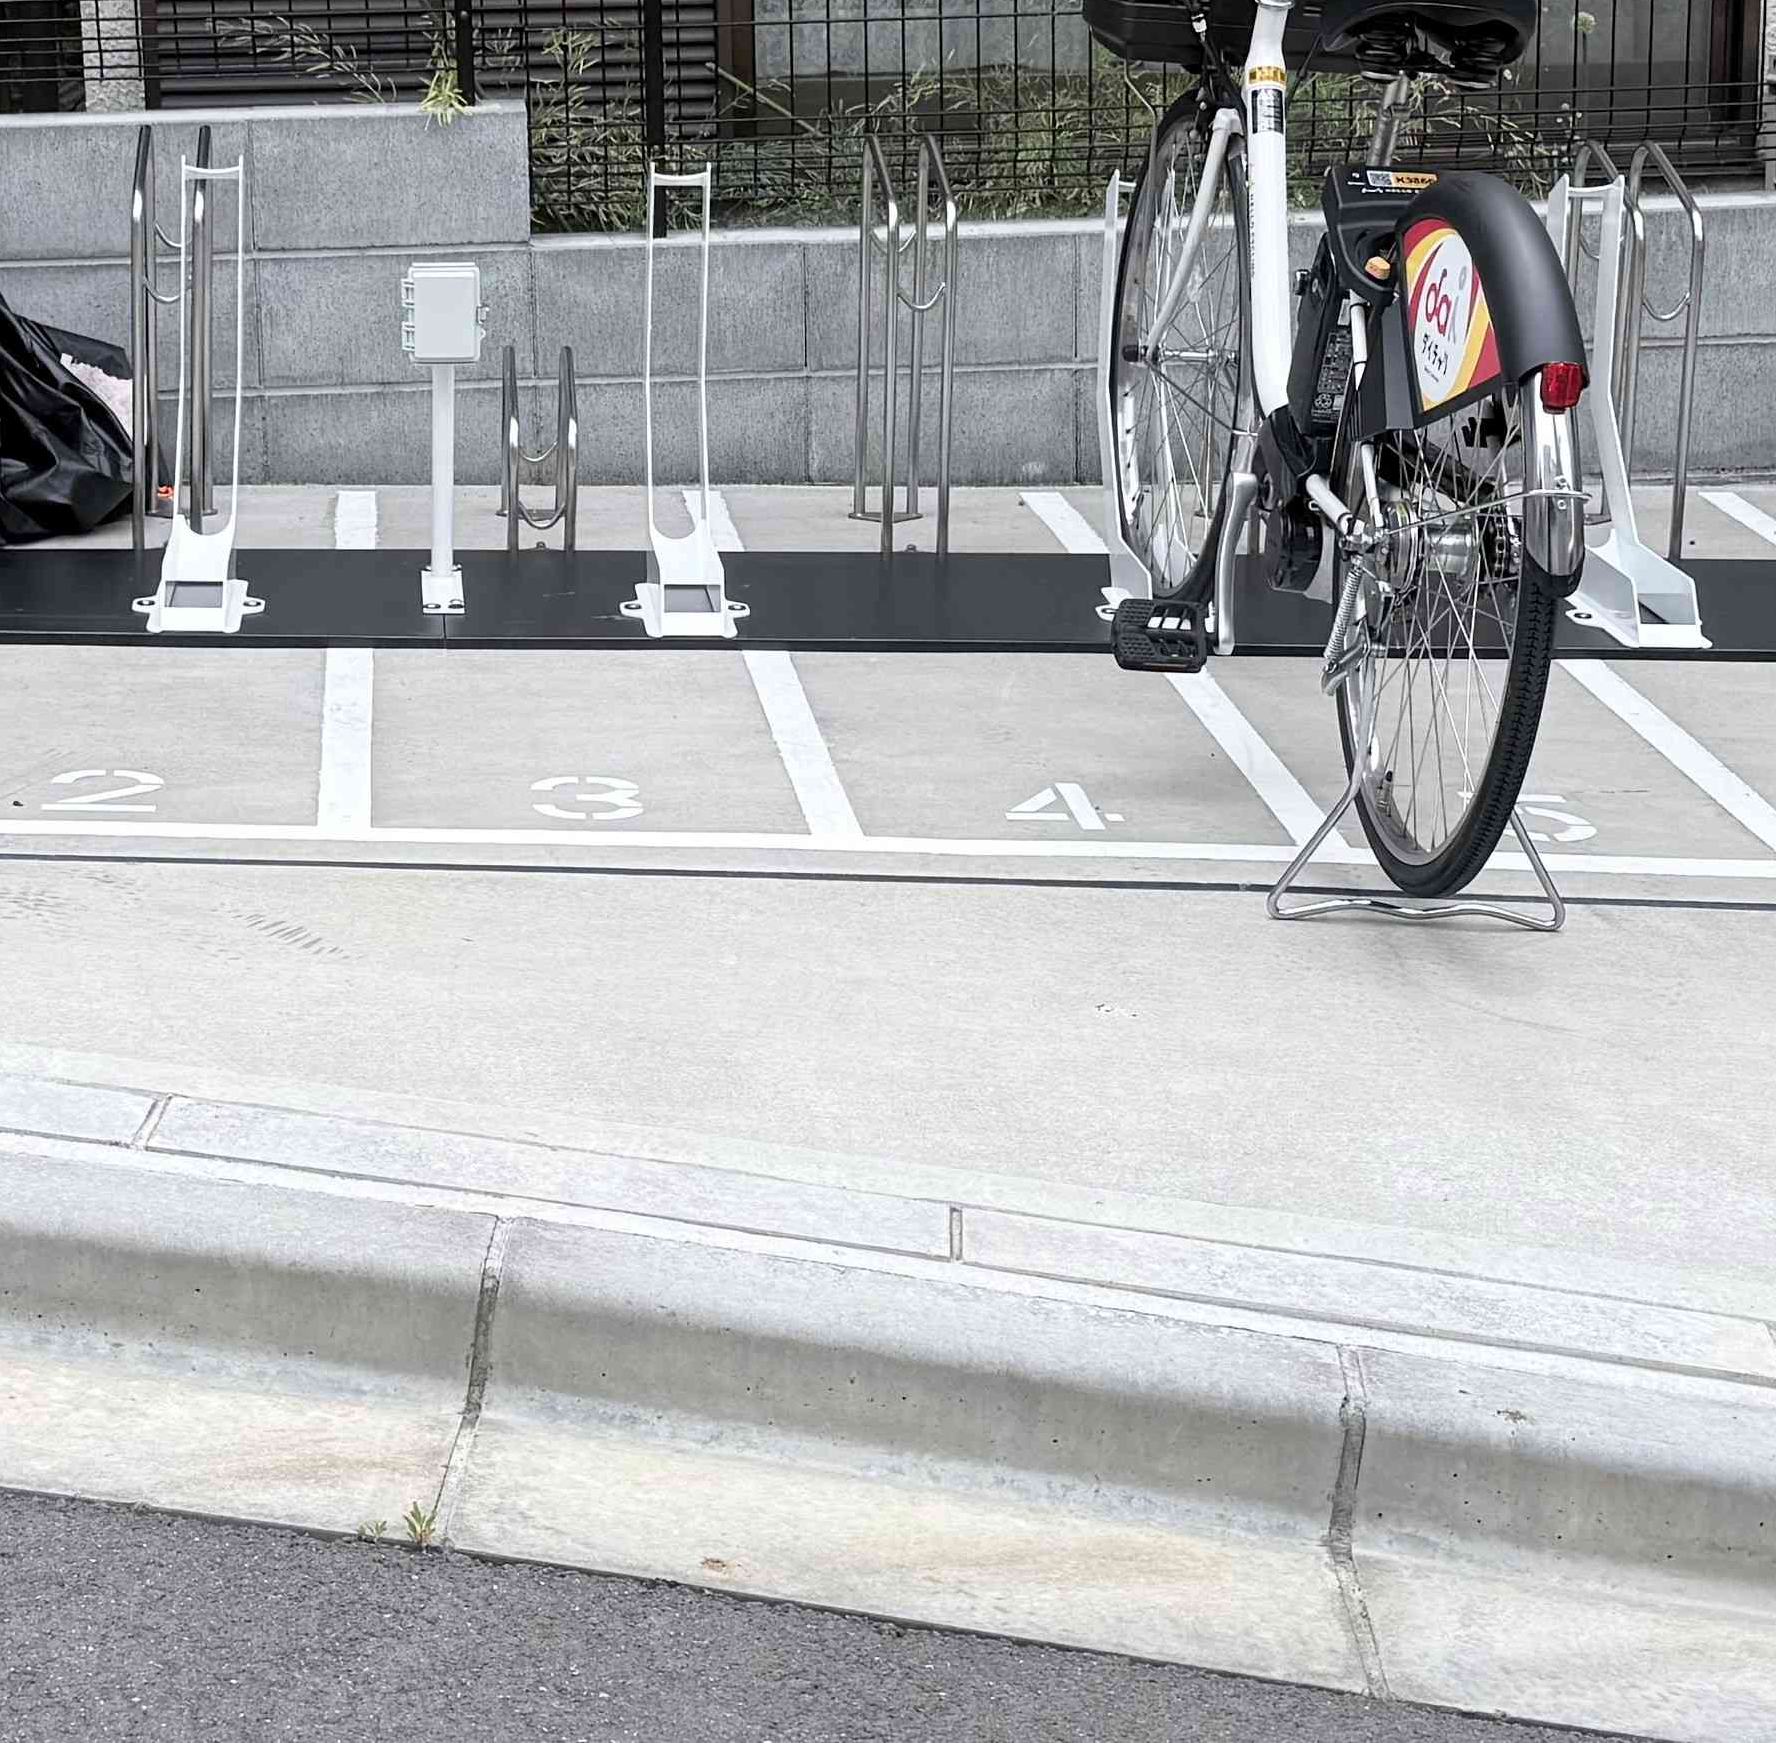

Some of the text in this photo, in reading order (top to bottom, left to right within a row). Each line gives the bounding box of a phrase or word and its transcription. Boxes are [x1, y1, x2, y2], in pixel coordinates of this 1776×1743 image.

[41, 769, 165, 813] 2
[530, 776, 645, 821] 3
[1005, 782, 1125, 830] 4
